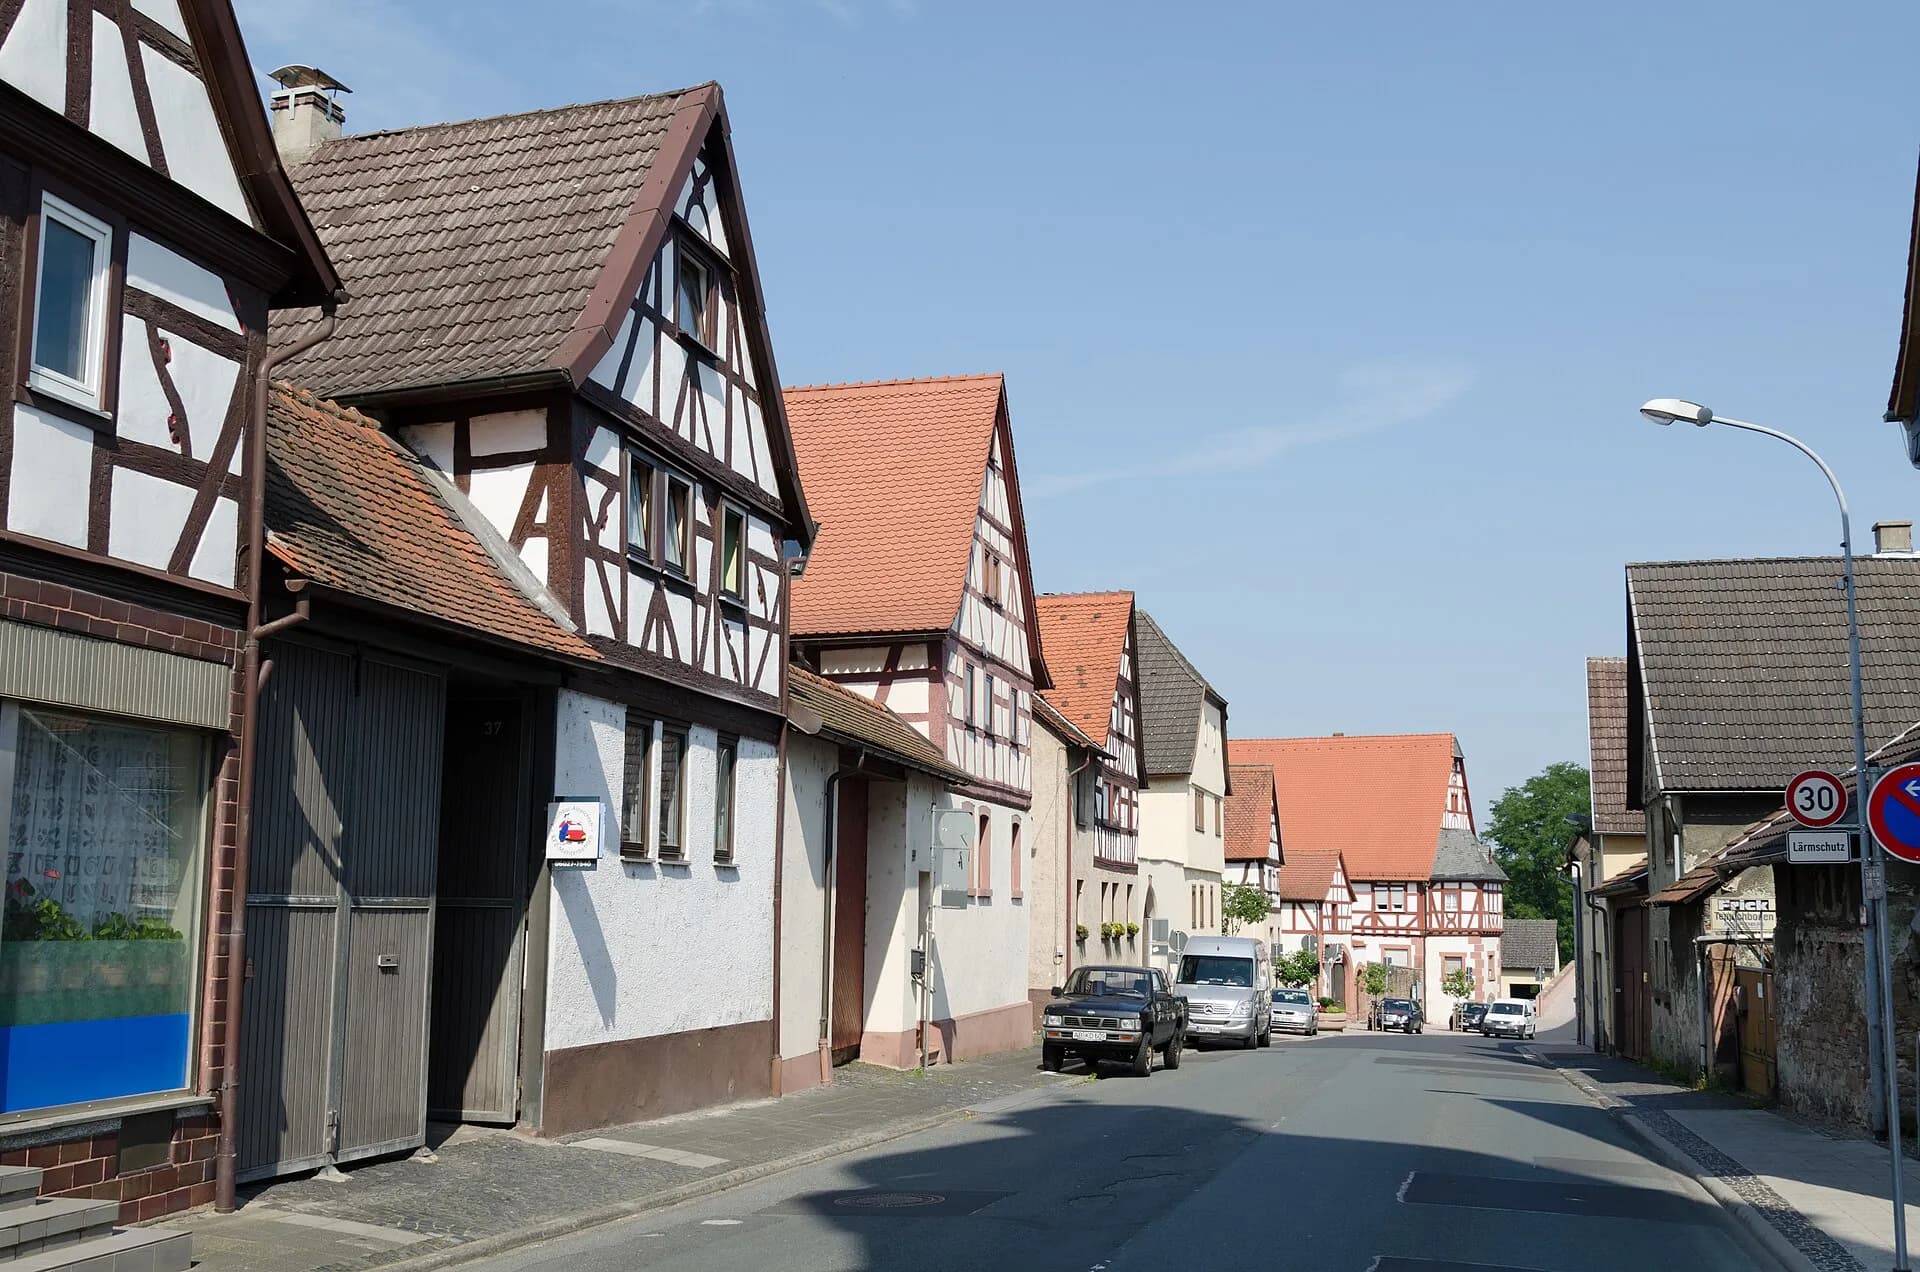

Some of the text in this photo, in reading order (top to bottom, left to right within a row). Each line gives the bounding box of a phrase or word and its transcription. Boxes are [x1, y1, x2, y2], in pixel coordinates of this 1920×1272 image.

[484, 721, 502, 735] 37
[1798, 786, 1834, 812] 30
[1792, 841, 1846, 853] Lärmschutz
[1718, 899, 1769, 911] Frick
